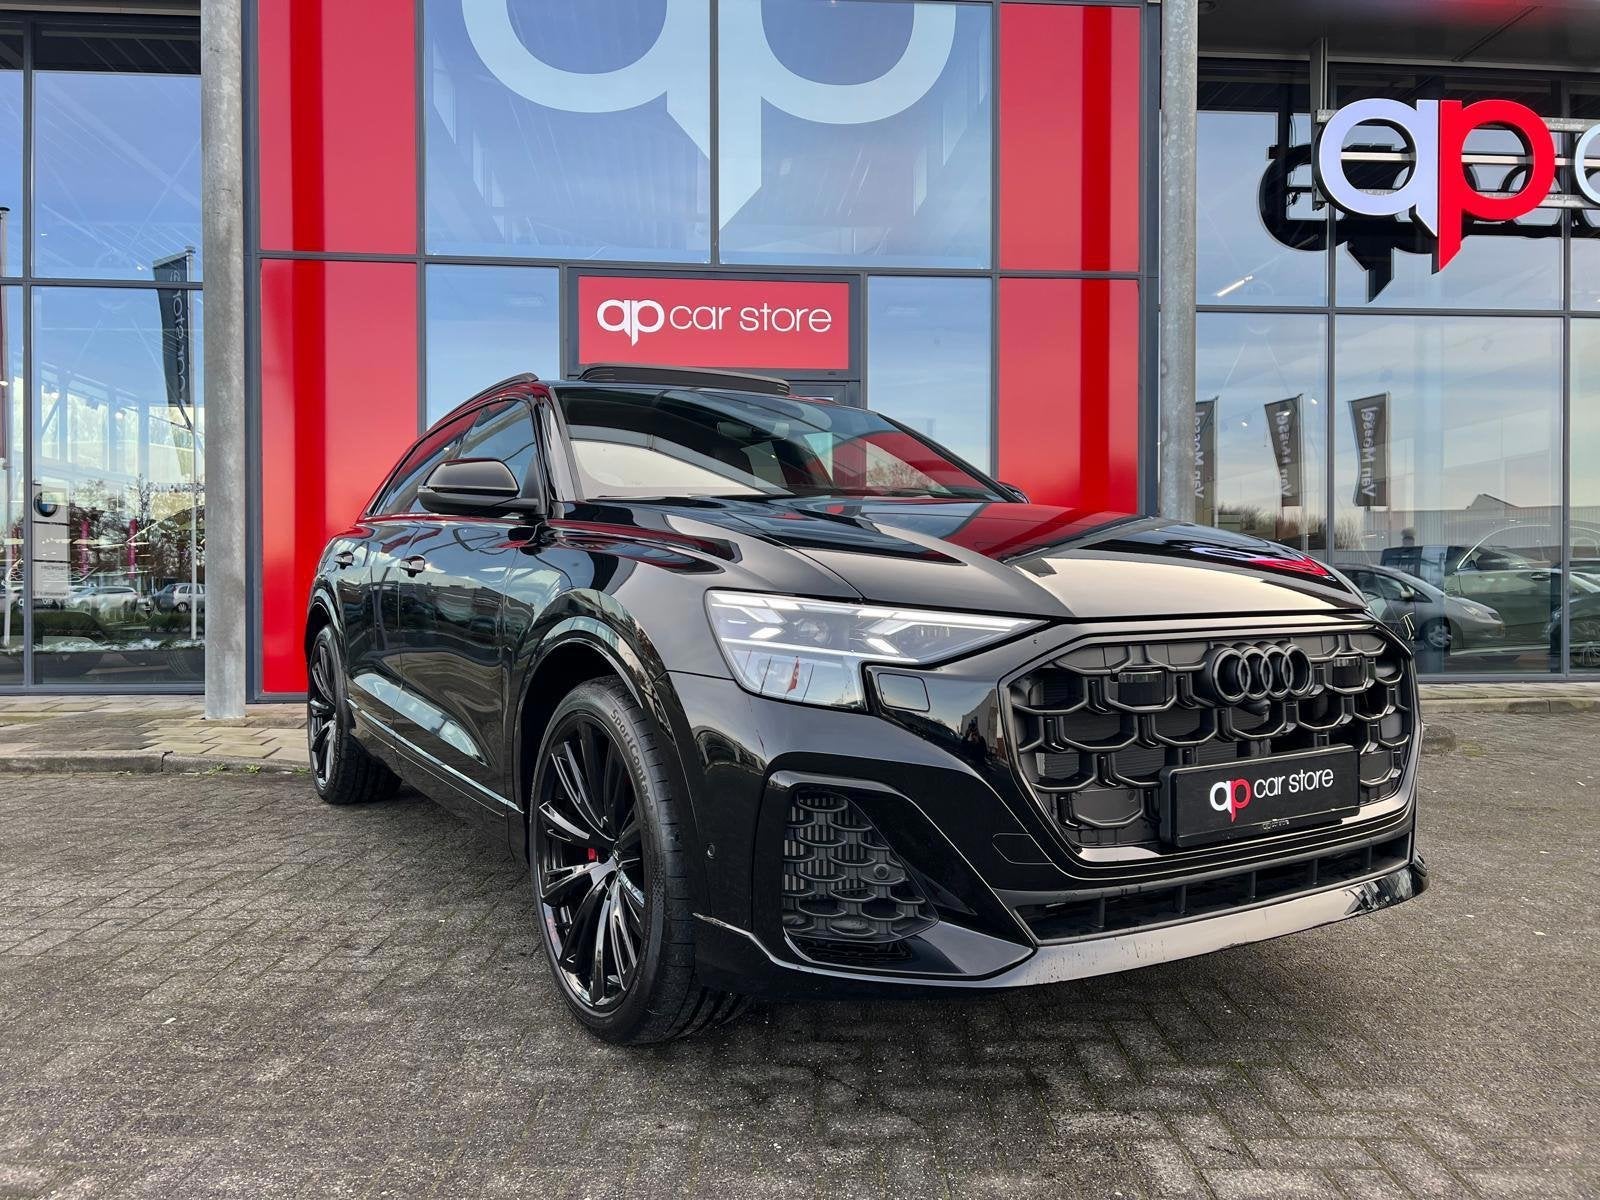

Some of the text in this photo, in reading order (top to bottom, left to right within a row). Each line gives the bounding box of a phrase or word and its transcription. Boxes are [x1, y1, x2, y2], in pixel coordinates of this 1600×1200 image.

[596, 299, 832, 347] ap car store
[1209, 768, 1334, 823] ap car store
